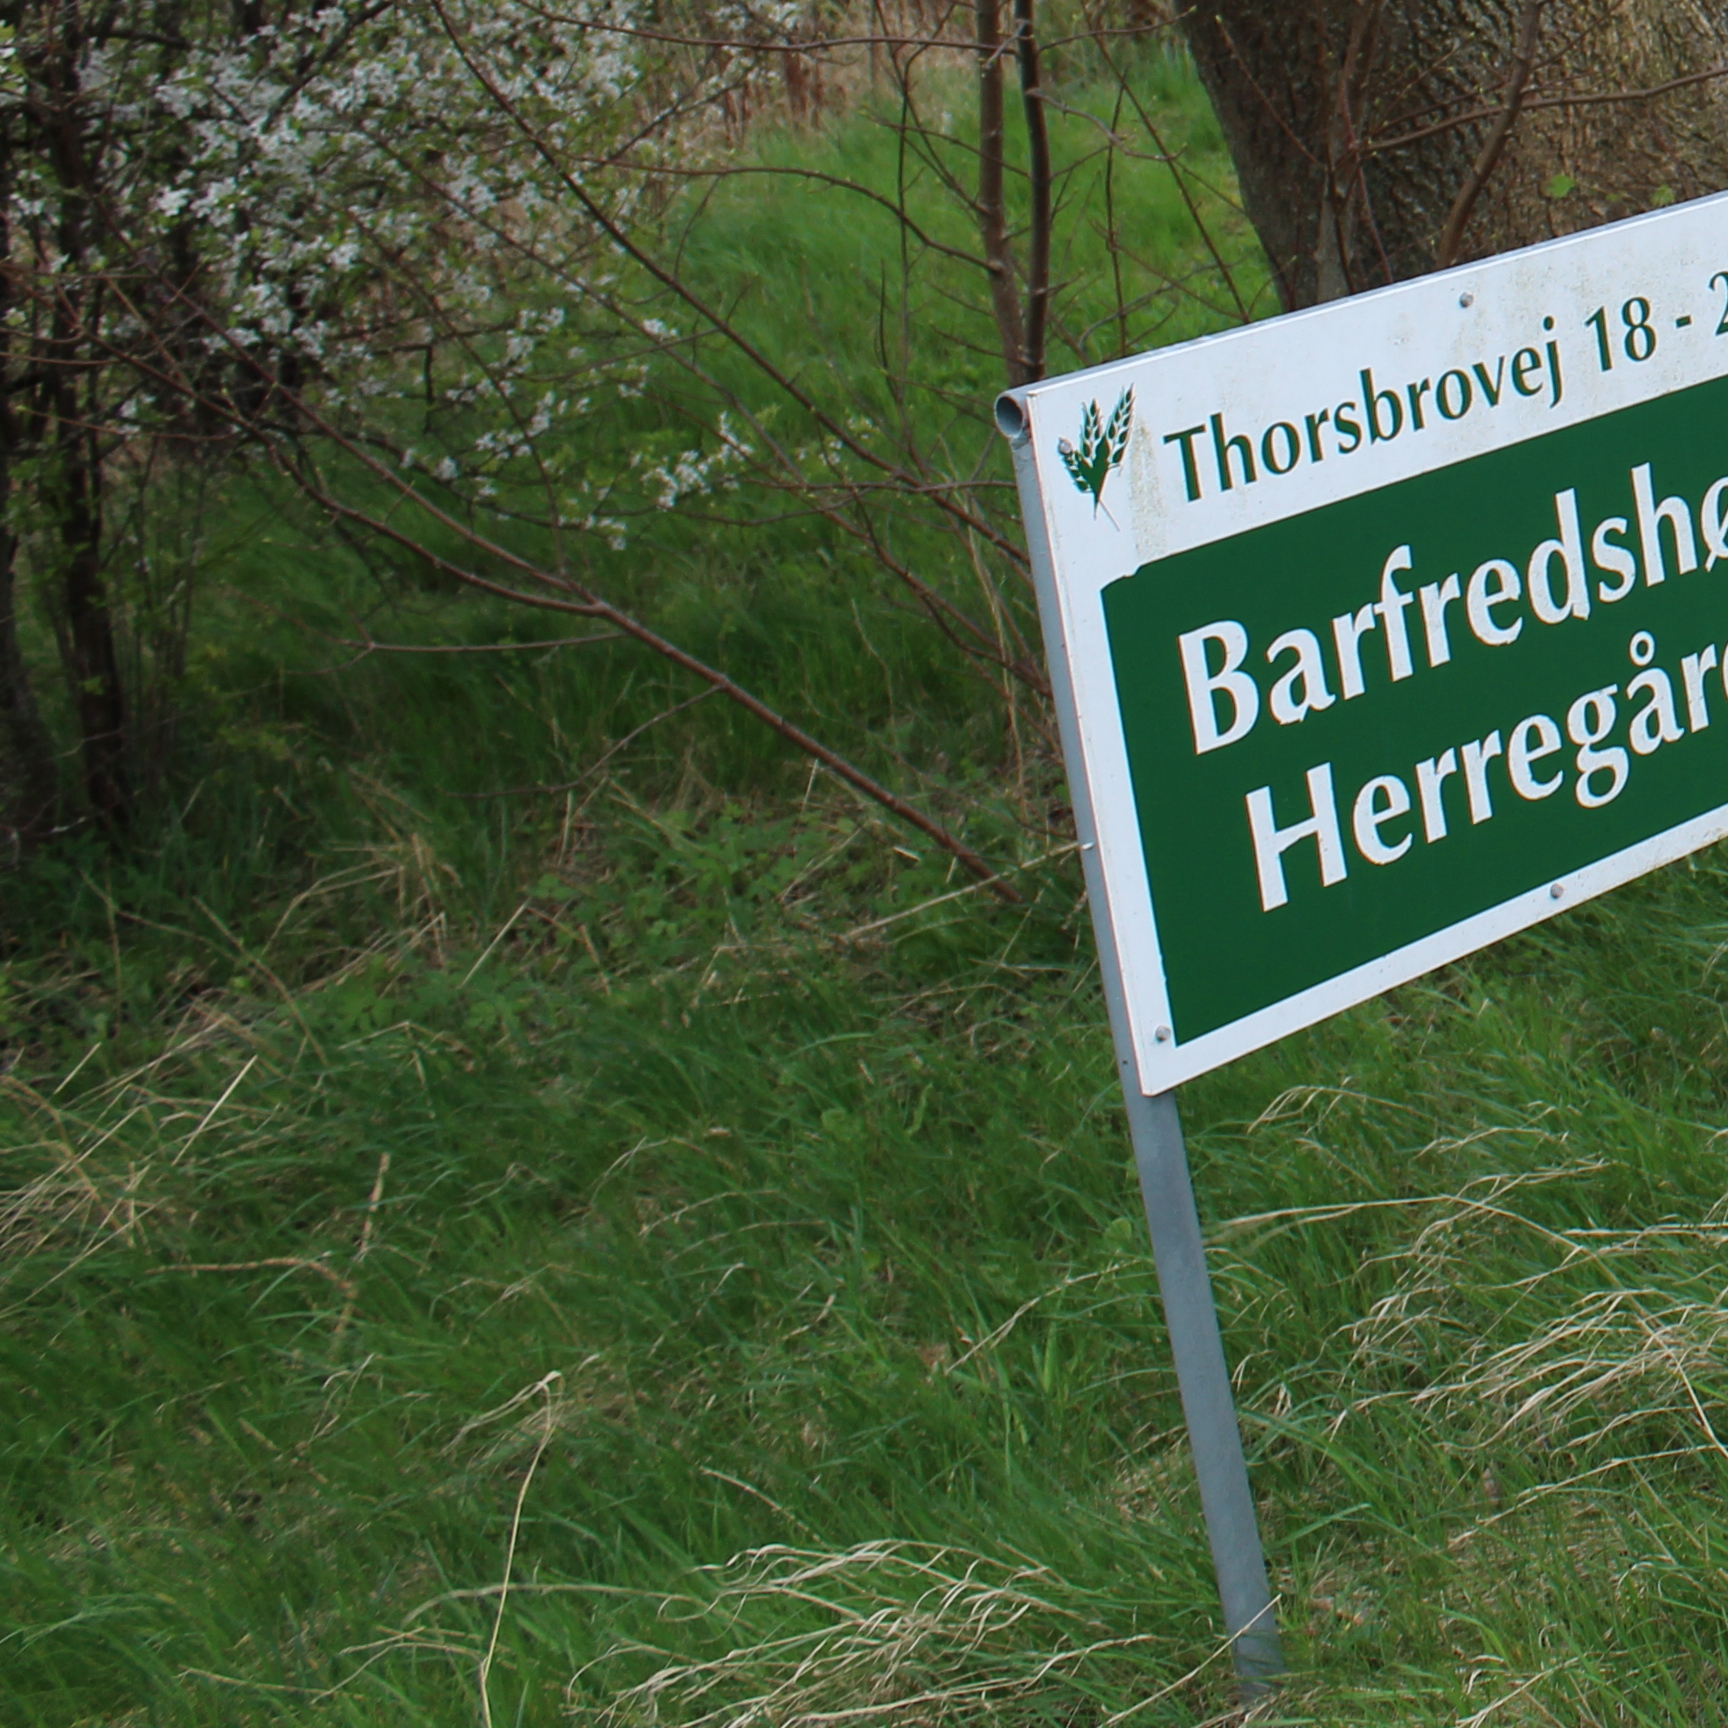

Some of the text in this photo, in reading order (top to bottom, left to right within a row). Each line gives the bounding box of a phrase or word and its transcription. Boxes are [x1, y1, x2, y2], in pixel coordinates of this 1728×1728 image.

[1162, 315, 1562, 504] Thorsbrovej
[1584, 295, 1657, 373] 18
[1675, 315, 1692, 329] -
